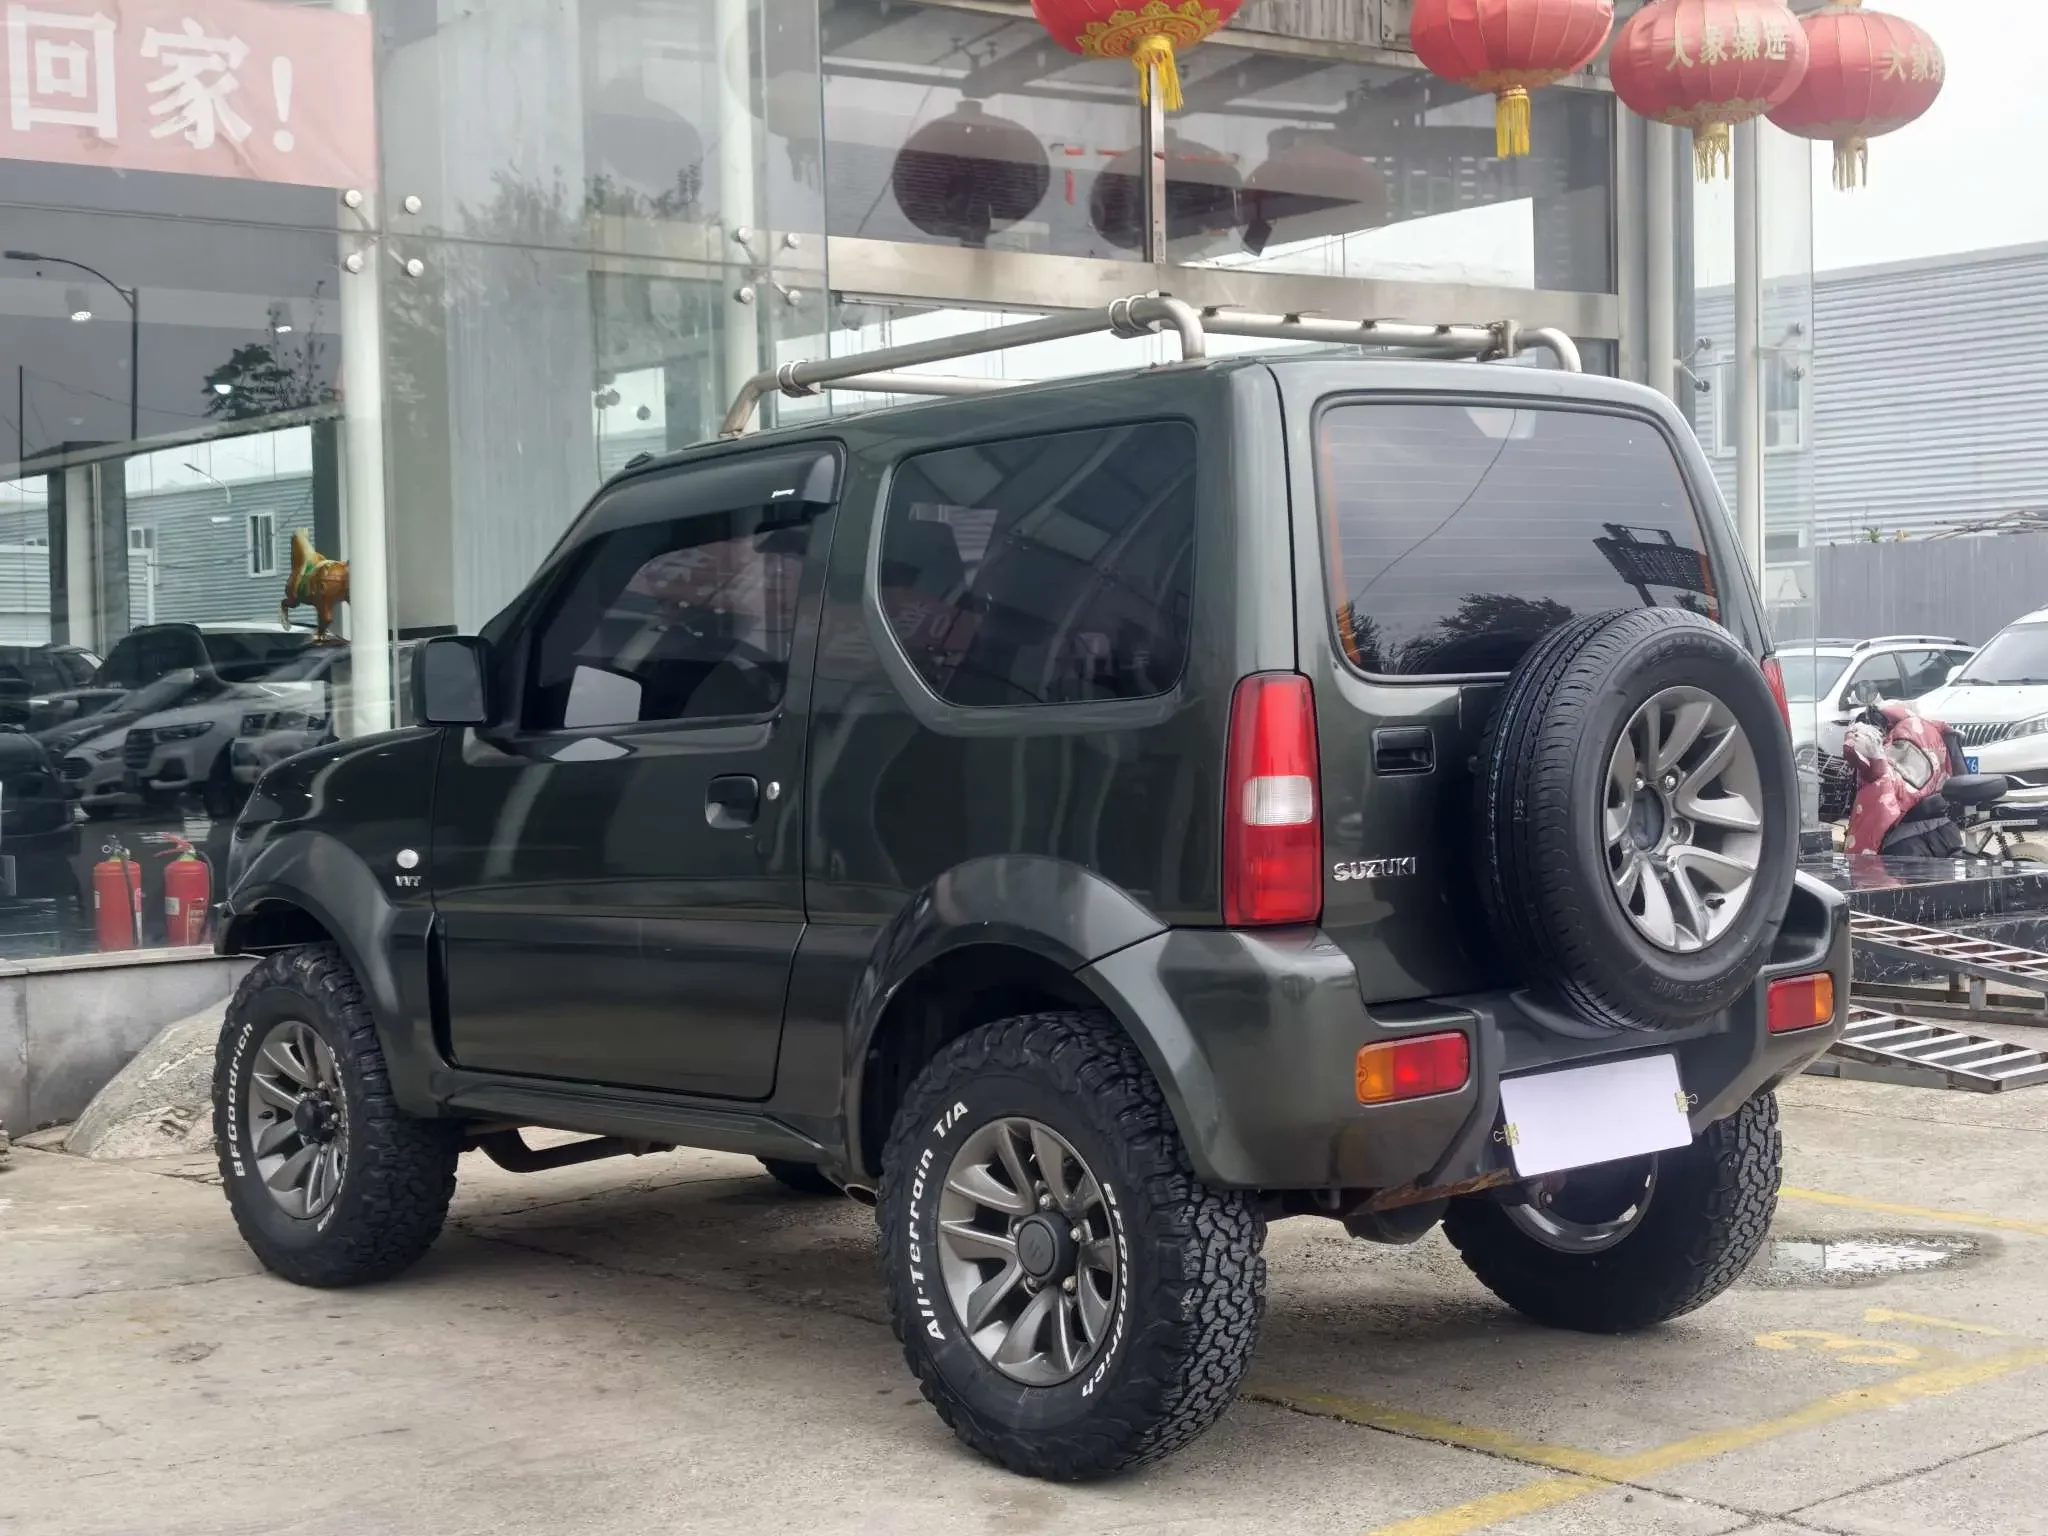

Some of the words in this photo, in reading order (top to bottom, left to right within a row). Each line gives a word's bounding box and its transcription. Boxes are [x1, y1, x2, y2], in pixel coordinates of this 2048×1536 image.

[1332, 856, 1416, 881] SUZUKI
[227, 1022, 254, 1177] BFGoodrich
[909, 1148, 946, 1341] All-Terrain
[933, 1101, 969, 1139] T/A
[1081, 1182, 1128, 1398] BFGoodrich
